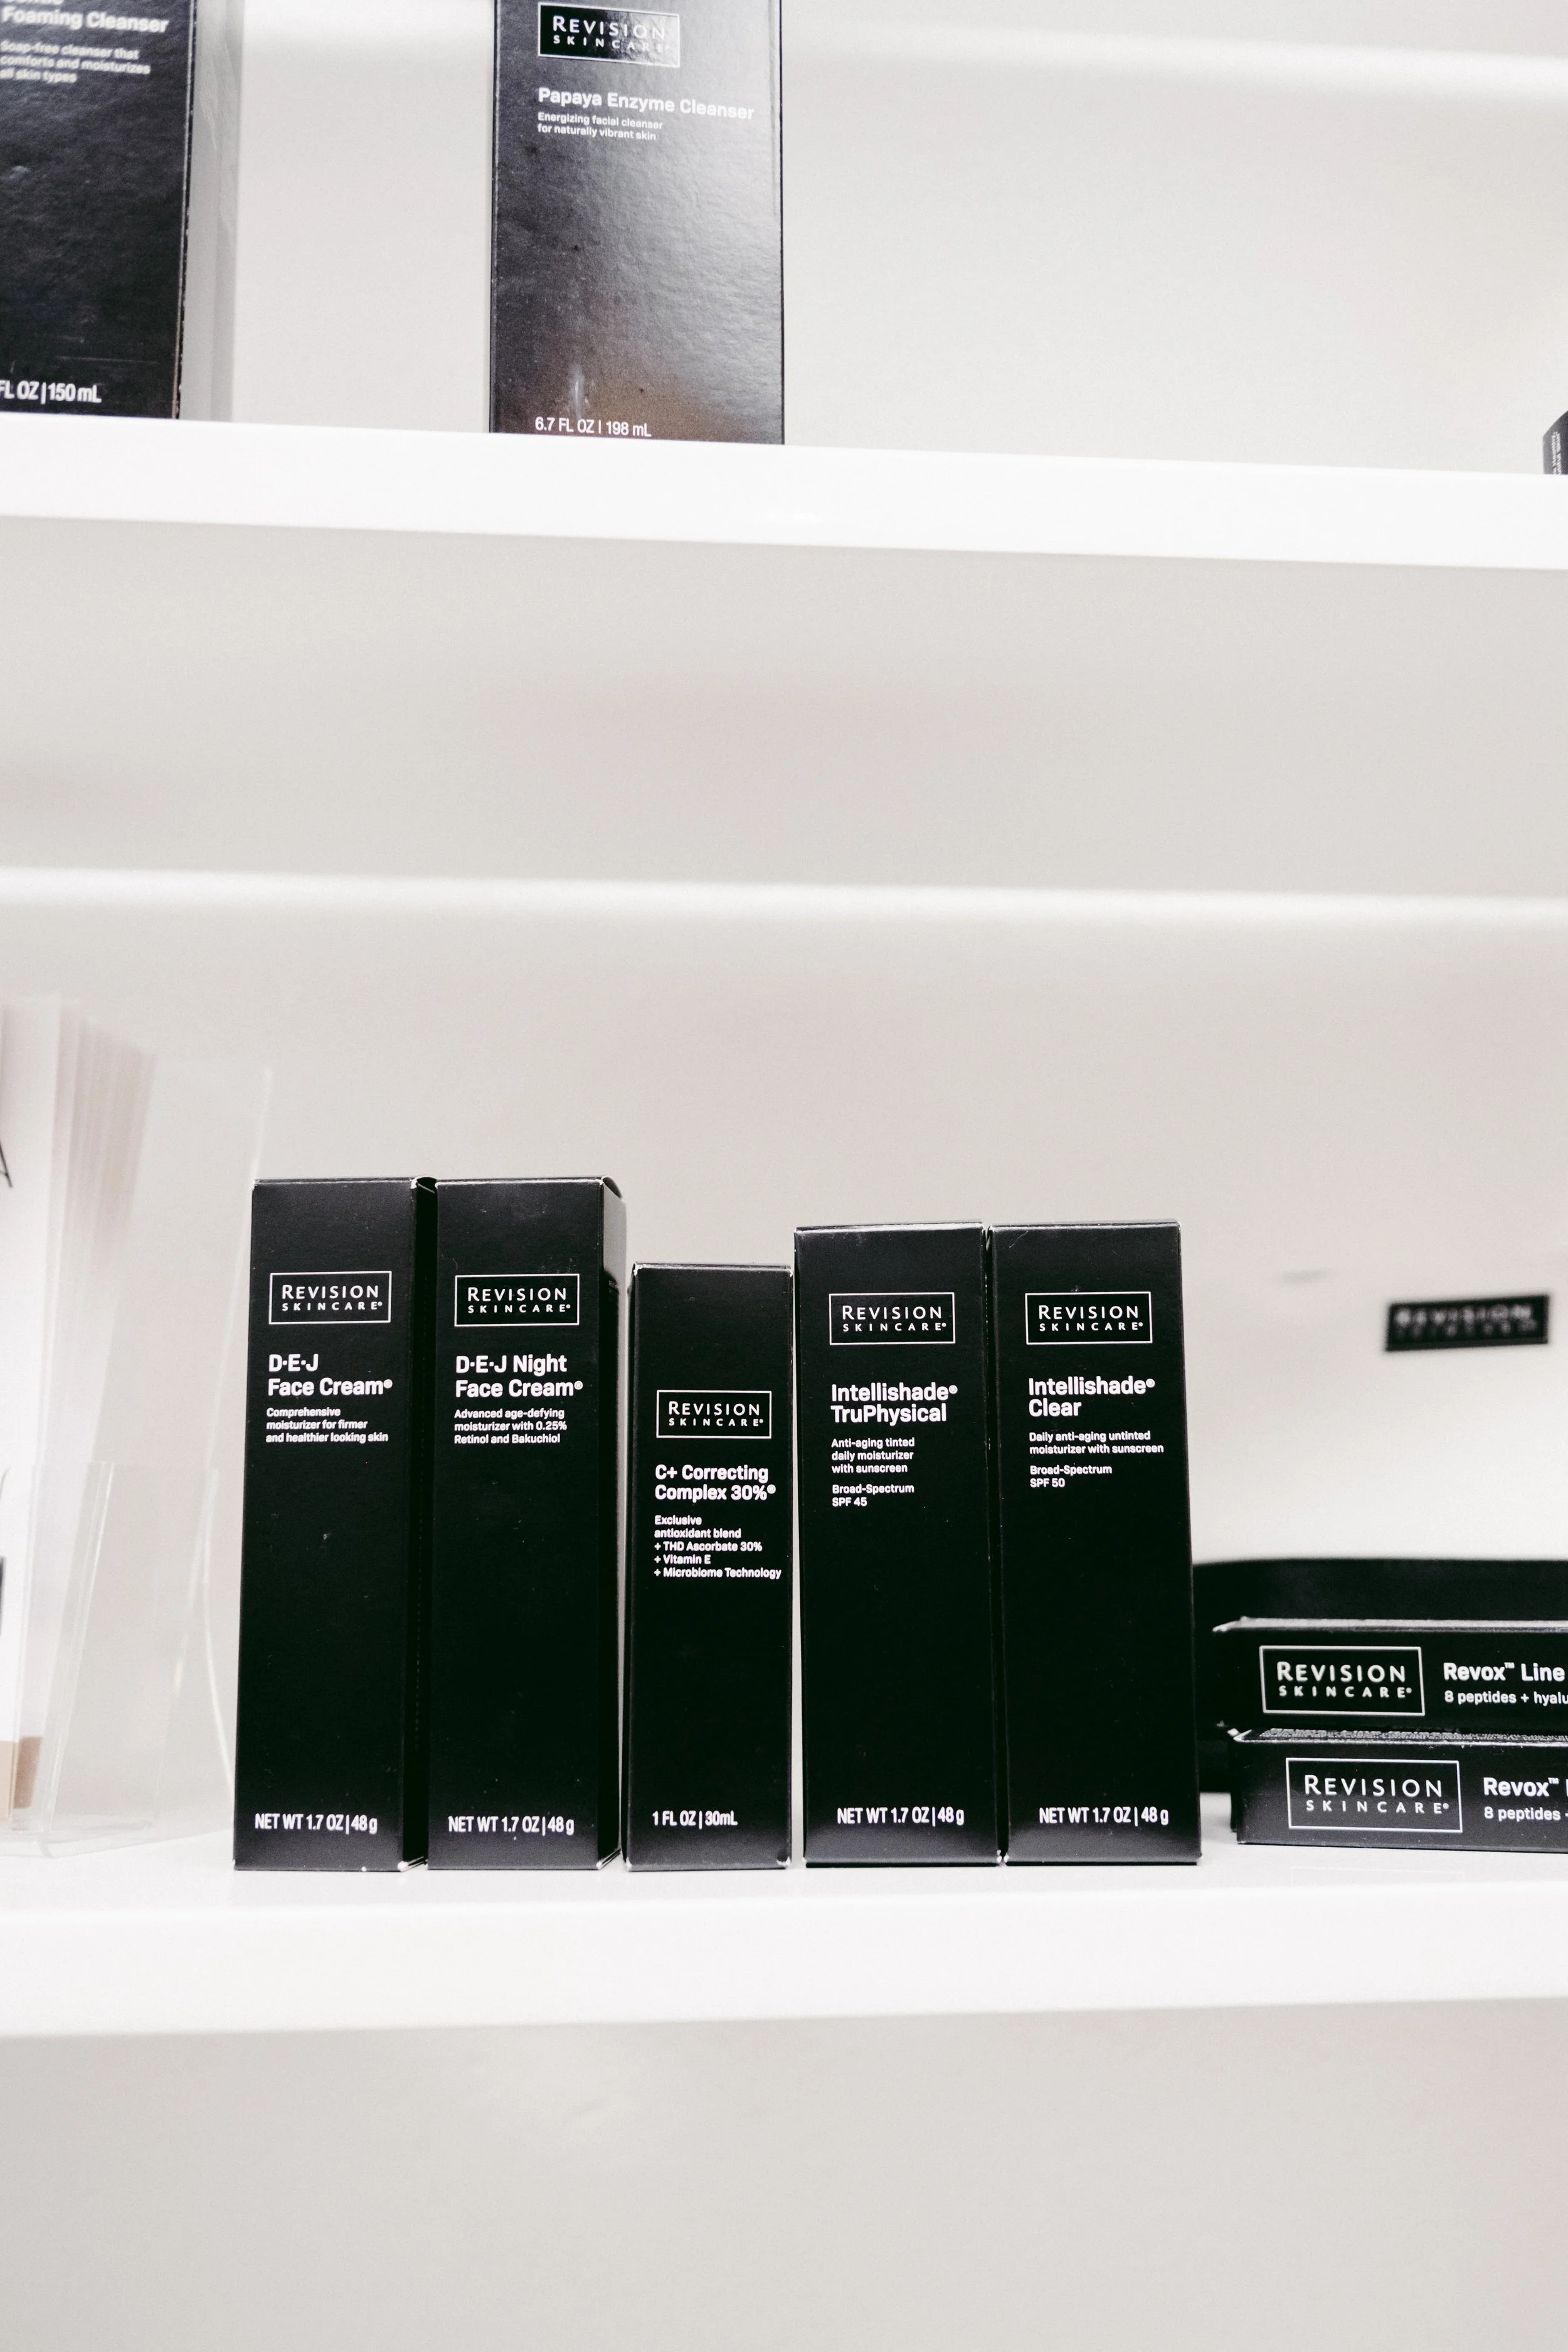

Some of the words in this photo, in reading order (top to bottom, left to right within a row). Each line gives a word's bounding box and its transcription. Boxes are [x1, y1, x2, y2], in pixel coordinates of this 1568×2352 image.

[2, 6, 82, 30] Foaming
[86, 11, 169, 32] Cleanser
[1, 40, 60, 53] Soap-free
[61, 45, 113, 58] cleanser
[114, 48, 139, 60] that
[56, 58, 80, 70] and
[82, 60, 151, 75] moisturizes
[16, 69, 41, 80] skin
[43, 71, 77, 83] types
[538, 87, 602, 109] Papaya
[607, 92, 675, 112] Enzyme
[680, 99, 755, 120] Cleanser
[538, 112, 590, 125] Energizing
[591, 115, 620, 125] facial
[621, 118, 663, 129] cleanser
[538, 124, 553, 134] for
[554, 125, 597, 137] naturally
[599, 129, 634, 138] vibrant
[635, 132, 656, 140] skin
[535, 416, 555, 432] 6.7
[558, 418, 574, 433] FL
[577, 419, 595, 434] OZ
[606, 421, 629, 436] 198
[632, 423, 652, 437] mL
[514, 1353, 567, 1376] Night
[268, 1379, 314, 1396] Face
[456, 1380, 503, 1397] Face
[267, 1407, 341, 1418] Comprehensive
[454, 1409, 502, 1418] Advanced
[505, 1408, 564, 1419] age-defying
[830, 1403, 946, 1426] TruPhysical
[1029, 1398, 1081, 1417] Clear
[267, 1420, 320, 1429] moisturizer
[322, 1419, 336, 1429] for
[336, 1419, 368, 1429] firmer
[455, 1421, 510, 1431] moisturizer
[512, 1421, 533, 1430] with
[536, 1421, 567, 1430] 0.25%
[266, 1433, 284, 1443] and
[286, 1433, 329, 1442] healthier
[331, 1432, 366, 1444] looking
[368, 1432, 388, 1441] skin
[455, 1434, 489, 1444] Retinol
[491, 1434, 509, 1443] and
[512, 1433, 560, 1443] Bakuchiol
[832, 1438, 883, 1449] Anti-aging
[885, 1437, 914, 1447] tinted
[1029, 1432, 1053, 1443] Daily
[1056, 1431, 1106, 1443] anti-aging
[1109, 1431, 1150, 1440] untinted
[832, 1451, 855, 1462] daily
[857, 1451, 913, 1460] moisturizer
[1030, 1444, 1086, 1454] moisturizer
[1088, 1444, 1110, 1453] with
[1112, 1445, 1163, 1453] sunscreen
[655, 1465, 677, 1480] C+
[682, 1465, 768, 1483] Correcting
[832, 1463, 854, 1473] with
[1030, 1465, 1112, 1476] Broad-Spectrum
[832, 1484, 914, 1495] Broad-Spectrum
[1030, 1478, 1049, 1488] SPF
[1052, 1478, 1065, 1487] 50
[655, 1484, 727, 1503] Complex
[832, 1497, 851, 1507] SPF
[854, 1497, 867, 1506] 45
[655, 1515, 702, 1525] Exclusive
[654, 1528, 711, 1538] antioxidant
[713, 1528, 741, 1538] blend
[663, 1541, 684, 1551] THD
[686, 1541, 738, 1551] Ascorbate
[740, 1542, 762, 1551] 30%
[663, 1554, 702, 1564] Vitamin
[704, 1554, 711, 1564] E
[664, 1567, 723, 1577] Microbiome
[724, 1567, 781, 1579] Technology
[1521, 1663, 1565, 1682] Line
[1445, 1690, 1454, 1702] 8
[1458, 1691, 1517, 1705] peptides
[1521, 1693, 1529, 1702] +
[255, 1813, 280, 1829] NET
[283, 1814, 304, 1830] WT
[306, 1814, 324, 1830] 1.7
[652, 1811, 658, 1825] 1
[662, 1811, 677, 1826] FL
[680, 1810, 696, 1826] OZ
[837, 1808, 863, 1824] NET
[866, 1808, 887, 1823] WT
[891, 1808, 908, 1823] 1.7
[1039, 1808, 1065, 1823] NET
[1067, 1807, 1089, 1823] WT
[1093, 1808, 1110, 1823] 1.7
[1113, 1806, 1131, 1823] OZ
[1484, 1806, 1493, 1819] 8
[1498, 1807, 1561, 1822] peptides
[448, 1816, 474, 1832] NET
[477, 1816, 499, 1832] WT
[502, 1816, 519, 1832] 1.7
